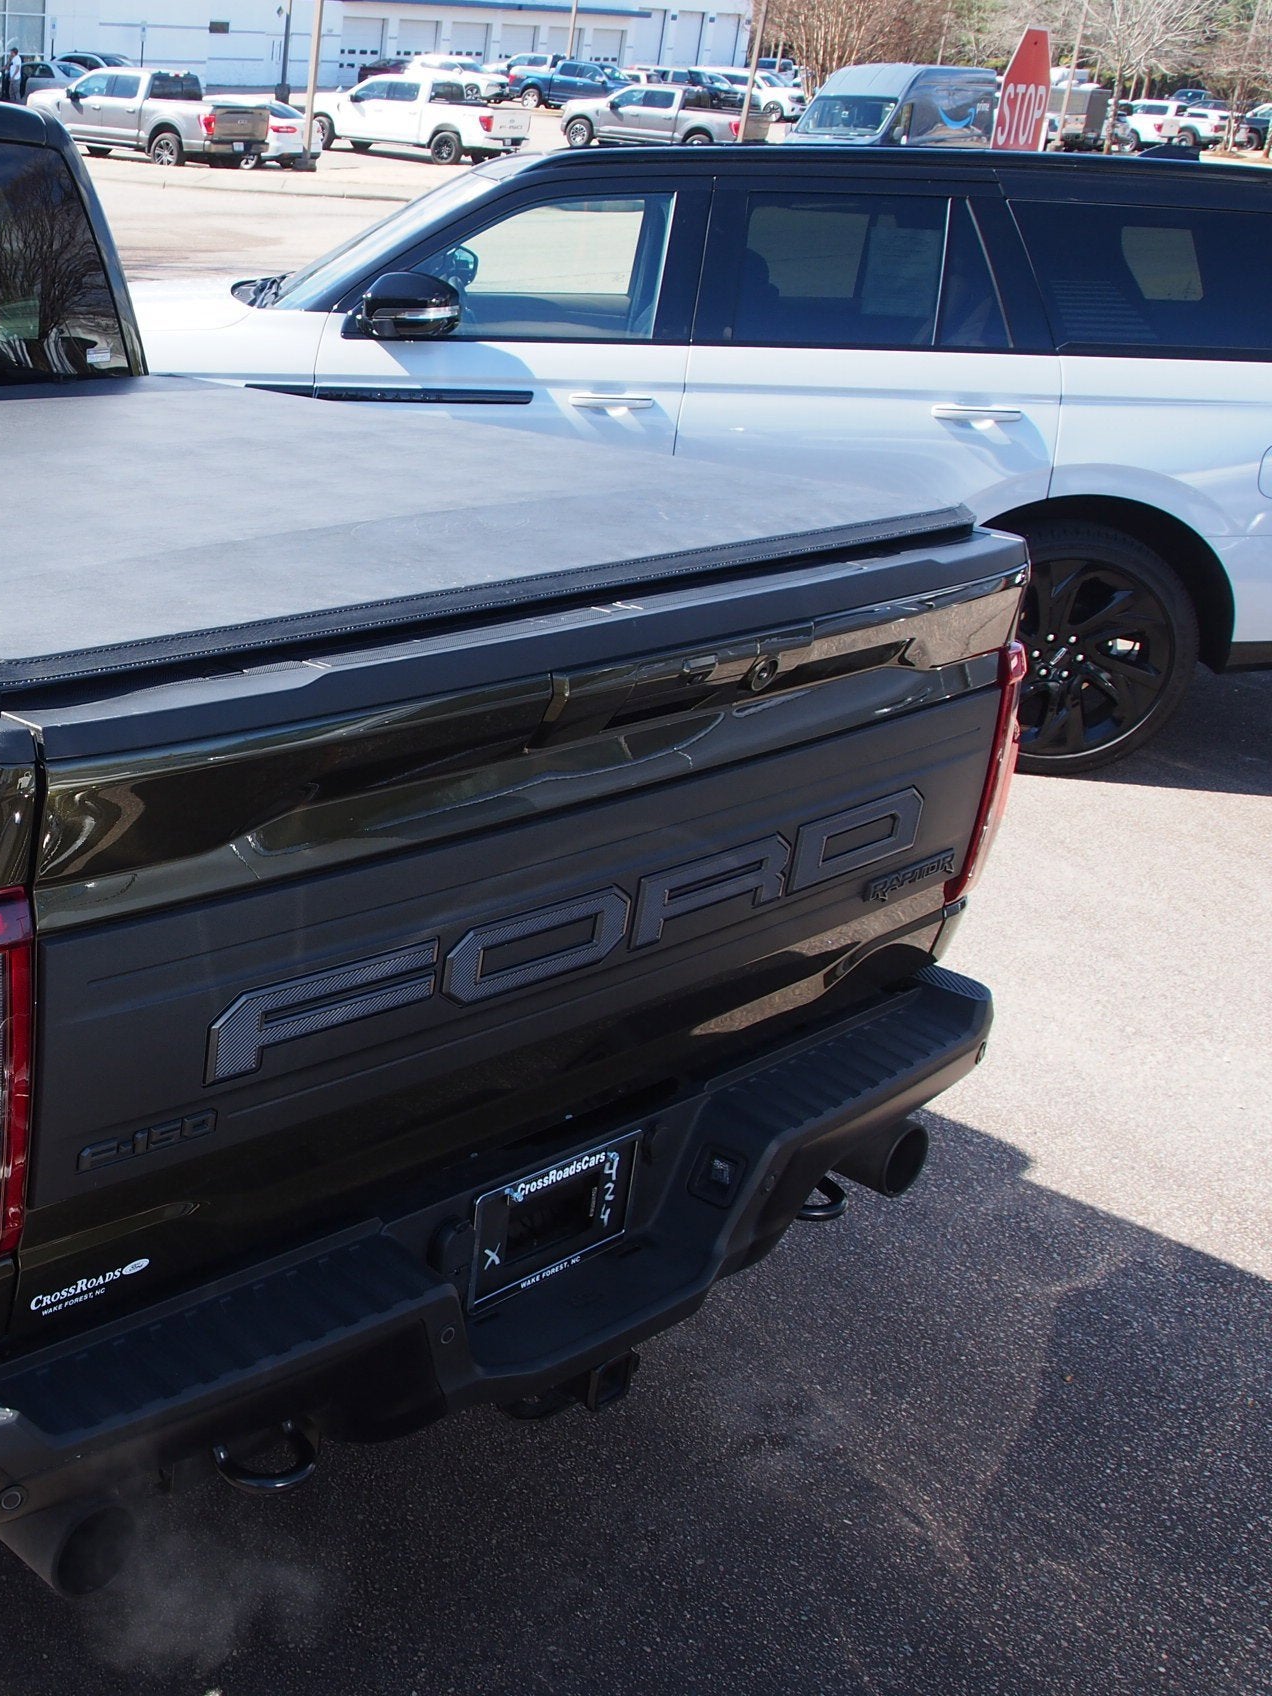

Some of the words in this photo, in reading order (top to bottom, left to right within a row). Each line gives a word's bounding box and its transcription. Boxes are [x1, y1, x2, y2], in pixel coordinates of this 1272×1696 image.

[976, 102, 990, 112] prime
[997, 83, 1046, 145] STOP
[865, 848, 955, 902] RAPTOR
[202, 785, 925, 1087] FORD
[76, 1108, 218, 1174] F-150
[517, 1152, 606, 1196] CrossRoadsCars
[521, 1274, 541, 1289] WAKE
[541, 1261, 570, 1279] FOREST,
[570, 1255, 581, 1265] NC
[41, 1303, 63, 1316] WAKE
[64, 1292, 94, 1308] FOREST,
[94, 1287, 106, 1297] NC
